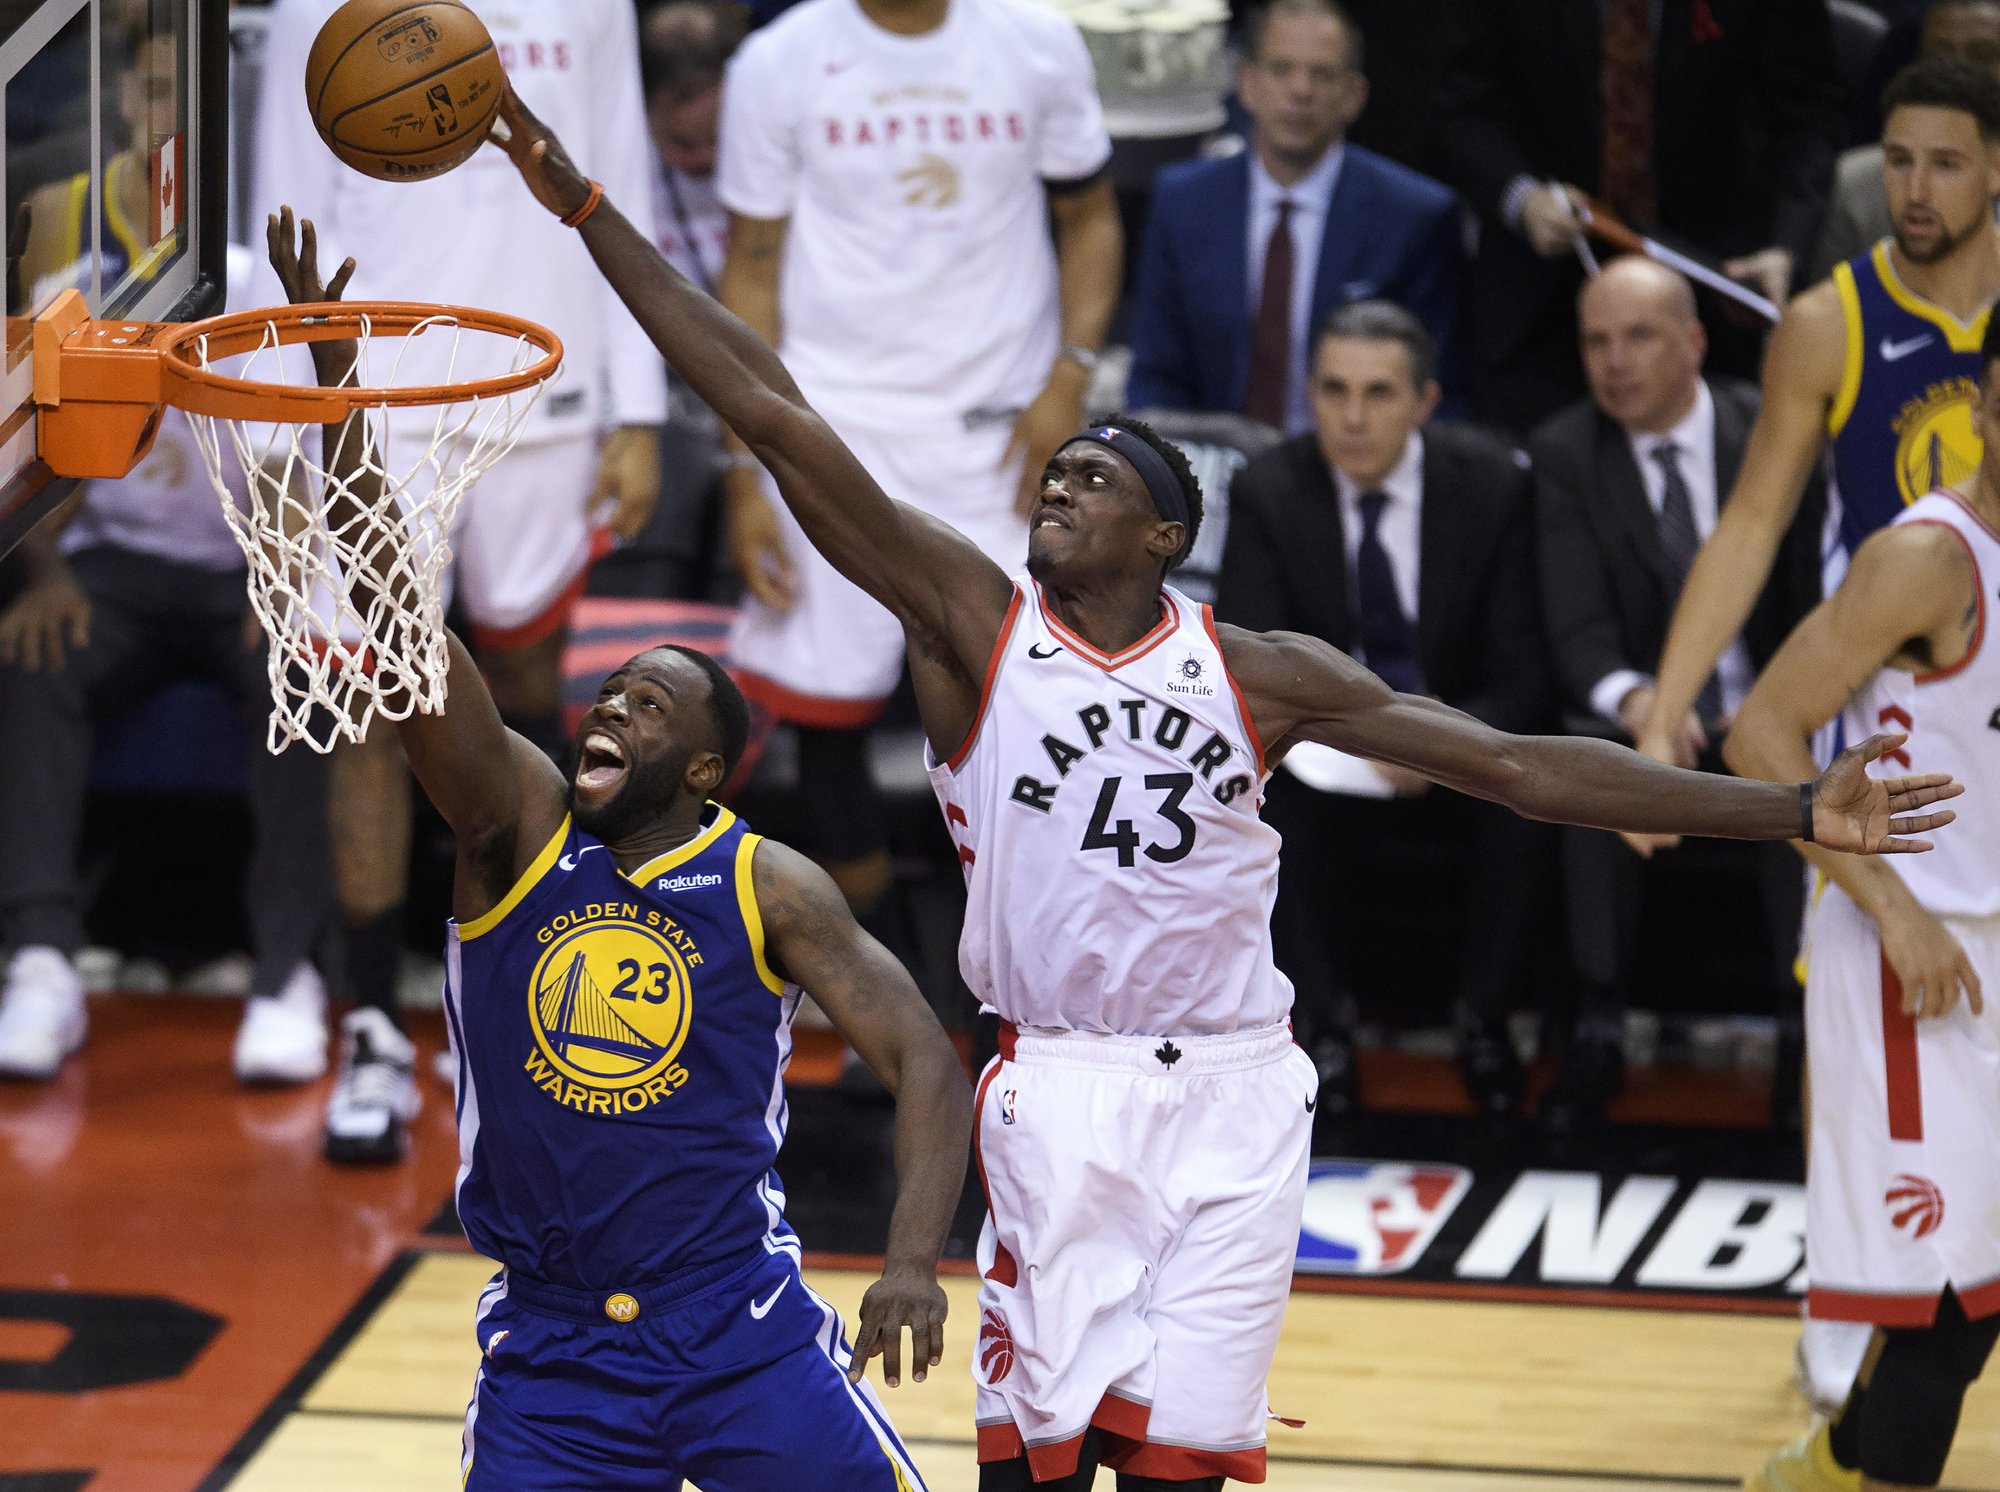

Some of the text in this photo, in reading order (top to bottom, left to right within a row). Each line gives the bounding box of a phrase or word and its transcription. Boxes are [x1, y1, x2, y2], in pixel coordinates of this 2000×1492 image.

[825, 112, 1024, 146] RAPTORS
[1166, 682, 1213, 696] Sun Life
[1008, 698, 1250, 815] RAPTORS
[1080, 772, 1197, 867] 43
[658, 873, 722, 891] Rakuten
[536, 902, 704, 969] GOLDEN STATE
[610, 958, 672, 1005] 23
[524, 1046, 689, 1115] WARRIORS
[1453, 1169, 1808, 1293] NB
[609, 1301, 634, 1317] W
